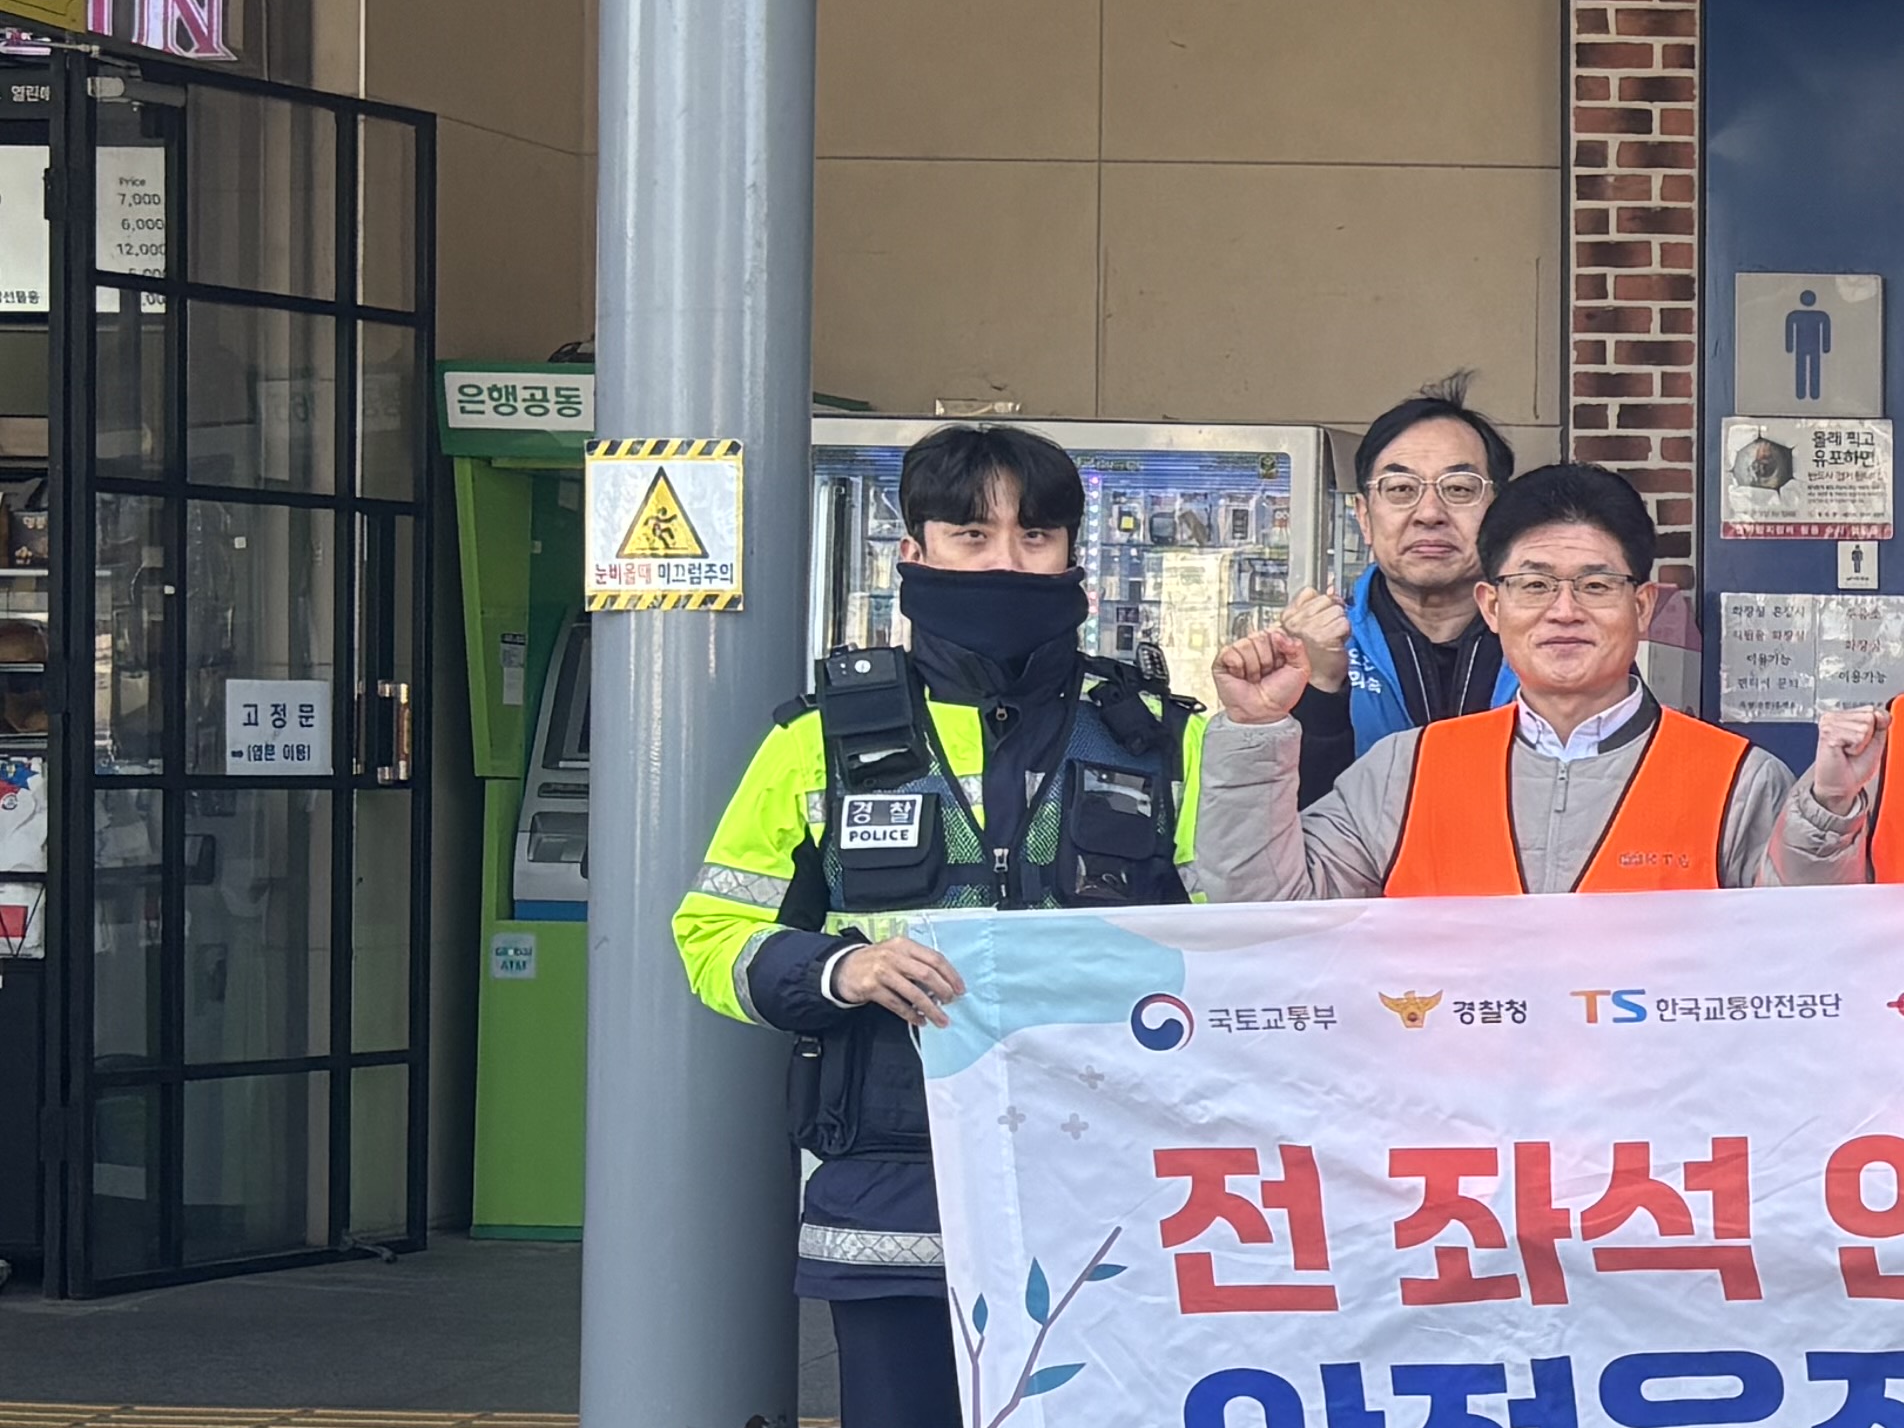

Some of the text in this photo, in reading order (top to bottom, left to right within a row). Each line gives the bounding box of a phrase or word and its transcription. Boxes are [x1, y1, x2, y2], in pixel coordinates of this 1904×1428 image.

[117, 192, 162, 208] 7,000
[121, 218, 165, 233] 6,000
[456, 383, 583, 419] 은행공동
[1812, 430, 1875, 449] 몰래 찍고
[1812, 449, 1876, 469] 유포하면
[657, 562, 735, 585] 미끄럼주의
[851, 800, 912, 824] 경찰
[849, 828, 909, 843] POLICE
[1452, 997, 1529, 1027] 경찰청
[1569, 987, 1843, 1025] TS 한국교통안전공단
[1208, 1003, 1339, 1034] 국토교통부
[1153, 1144, 1339, 1314] 전
[1387, 1136, 1764, 1307] 좌석
